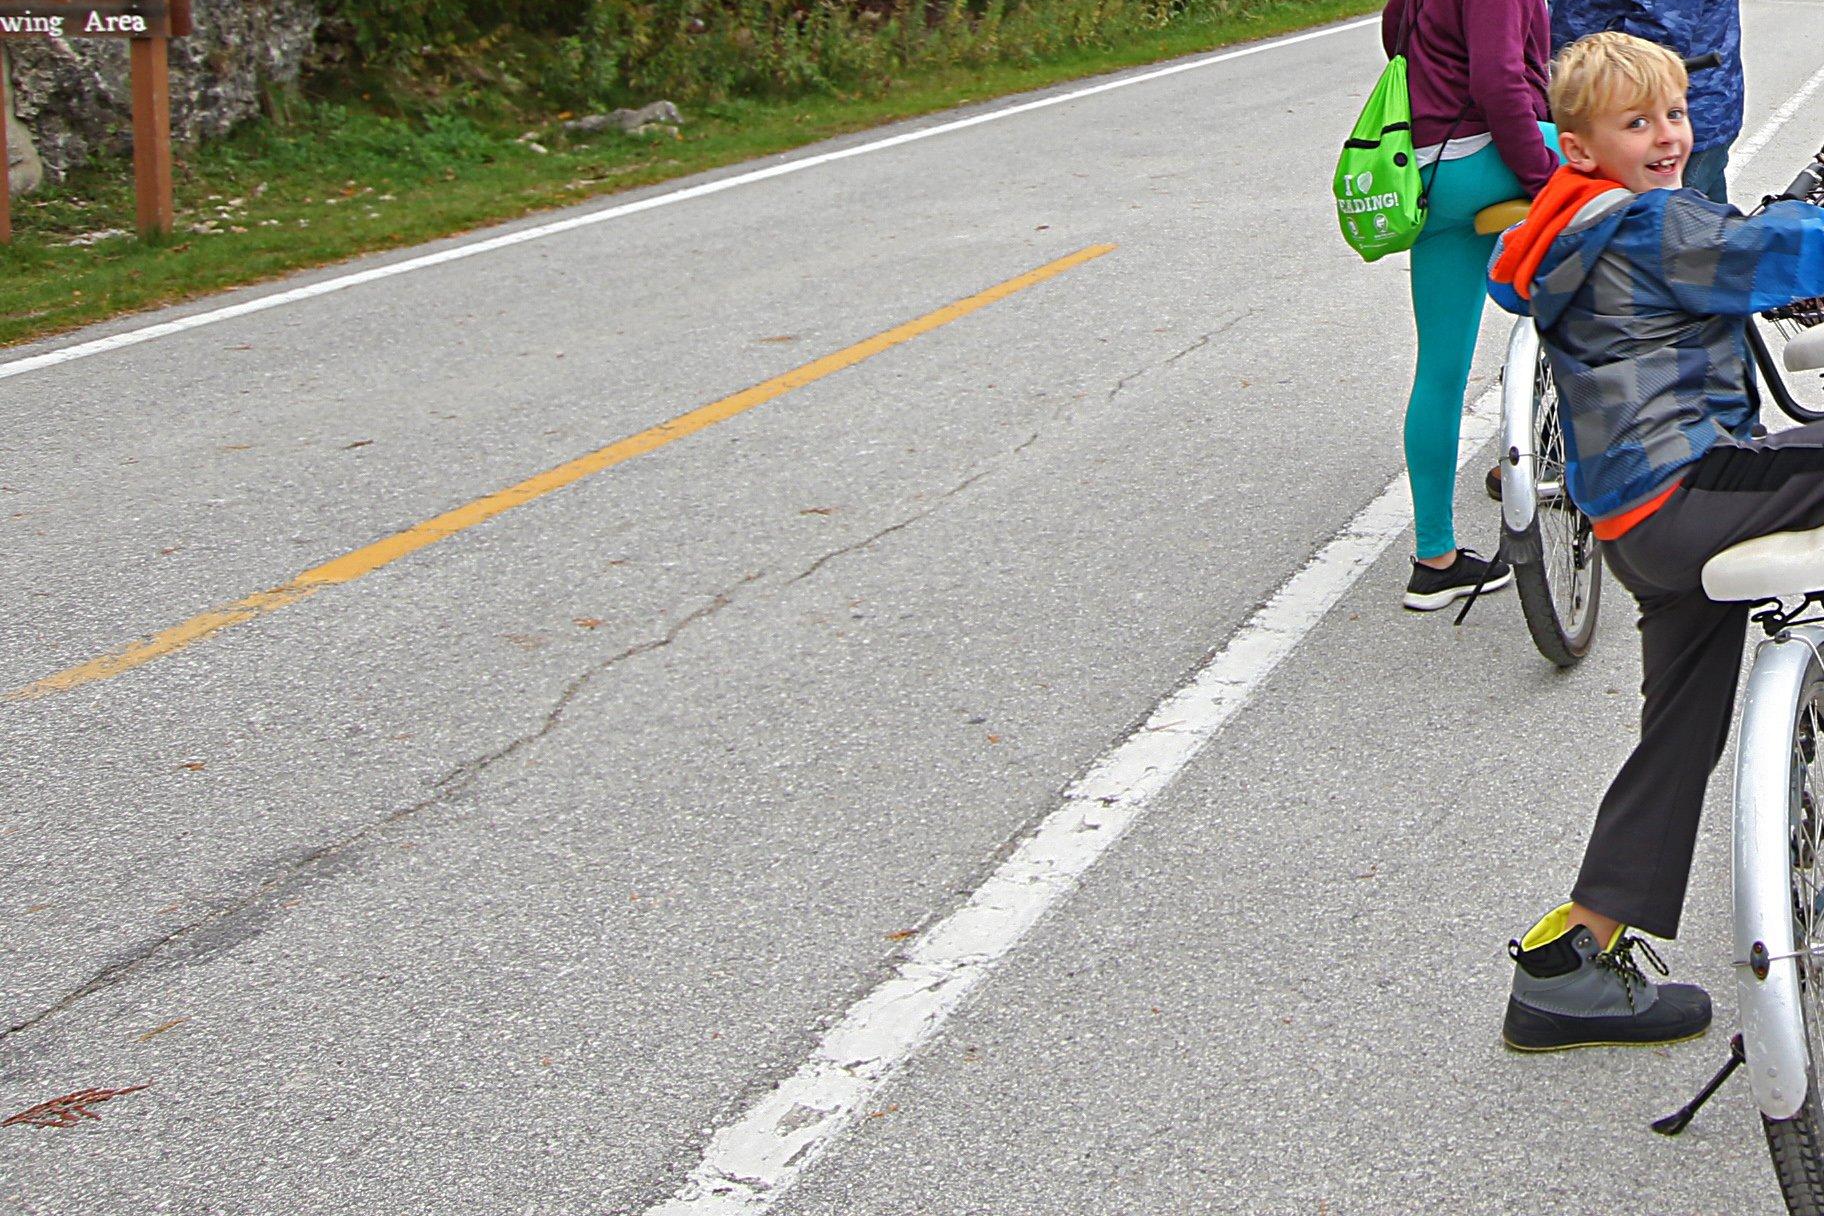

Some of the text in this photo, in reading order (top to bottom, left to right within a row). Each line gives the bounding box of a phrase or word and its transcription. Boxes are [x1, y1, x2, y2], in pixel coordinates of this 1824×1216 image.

[0, 10, 147, 37] wing Area
[1344, 174, 1353, 196] I
